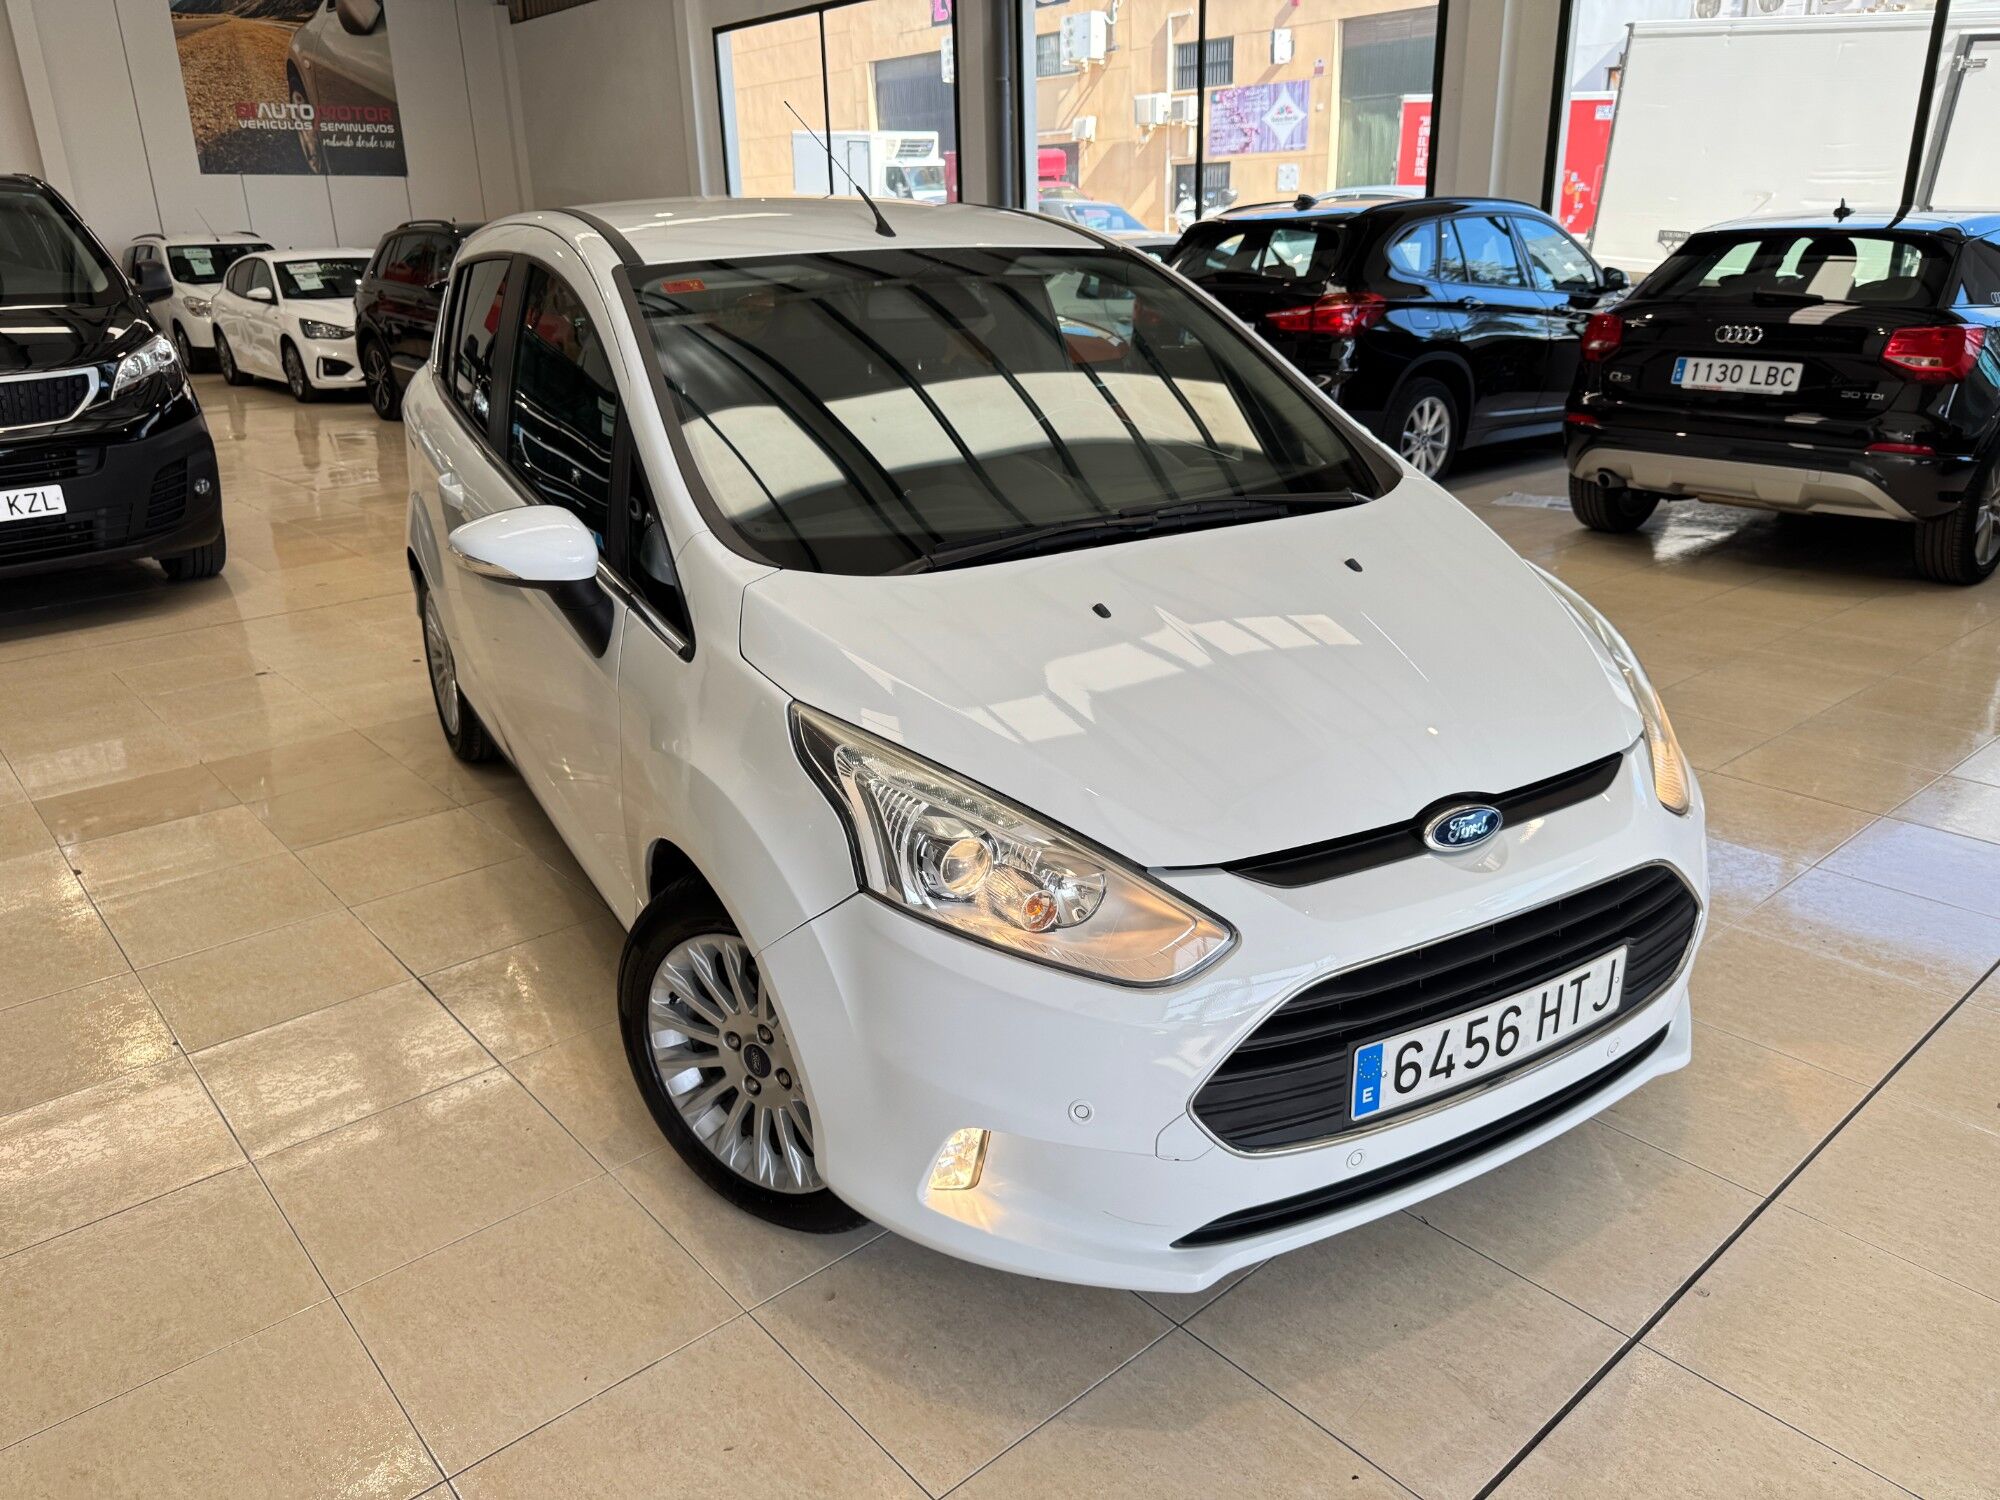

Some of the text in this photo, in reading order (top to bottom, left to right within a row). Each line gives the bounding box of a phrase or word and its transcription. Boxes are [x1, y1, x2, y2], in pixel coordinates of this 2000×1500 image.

[239, 119, 395, 134] VEHICULOS SEMINUEVOS
[1690, 362, 1743, 383] 1130
[1750, 365, 1795, 387] LBC
[1863, 391, 1884, 401] TDI
[6, 491, 59, 516] KZL
[1448, 814, 1488, 843] Ford
[1394, 959, 1617, 1094] 6456 HTJ
[1362, 1087, 1373, 1103] E
